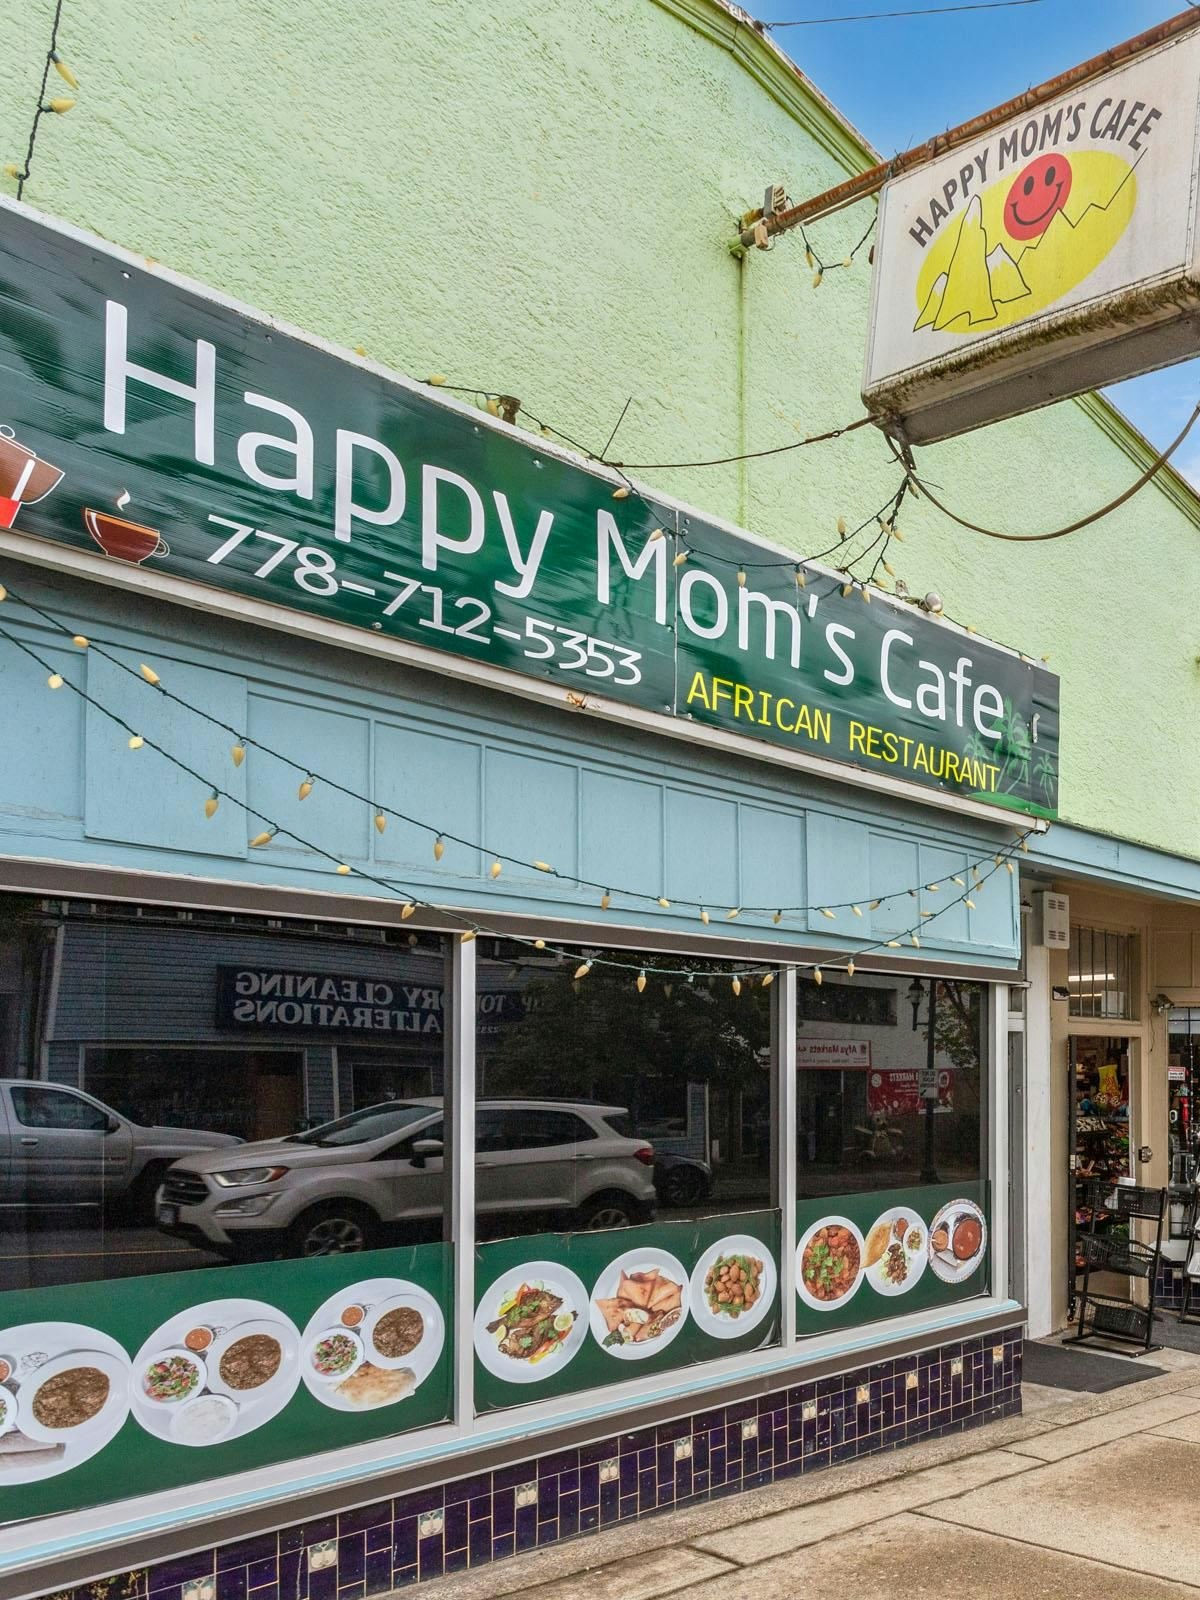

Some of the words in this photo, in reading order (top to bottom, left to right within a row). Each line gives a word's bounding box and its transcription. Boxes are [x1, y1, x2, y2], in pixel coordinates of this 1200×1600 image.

[908, 148, 990, 248] HAPPY
[999, 102, 1086, 171] MOM'S
[1089, 97, 1163, 151] CAFE
[104, 300, 554, 600] Happy
[597, 508, 856, 686] Mom's
[881, 629, 1005, 739] Cafe
[206, 514, 643, 686] 778-712-5353
[687, 672, 831, 744] AFRICAN
[850, 721, 1001, 793] RESTAURANT
